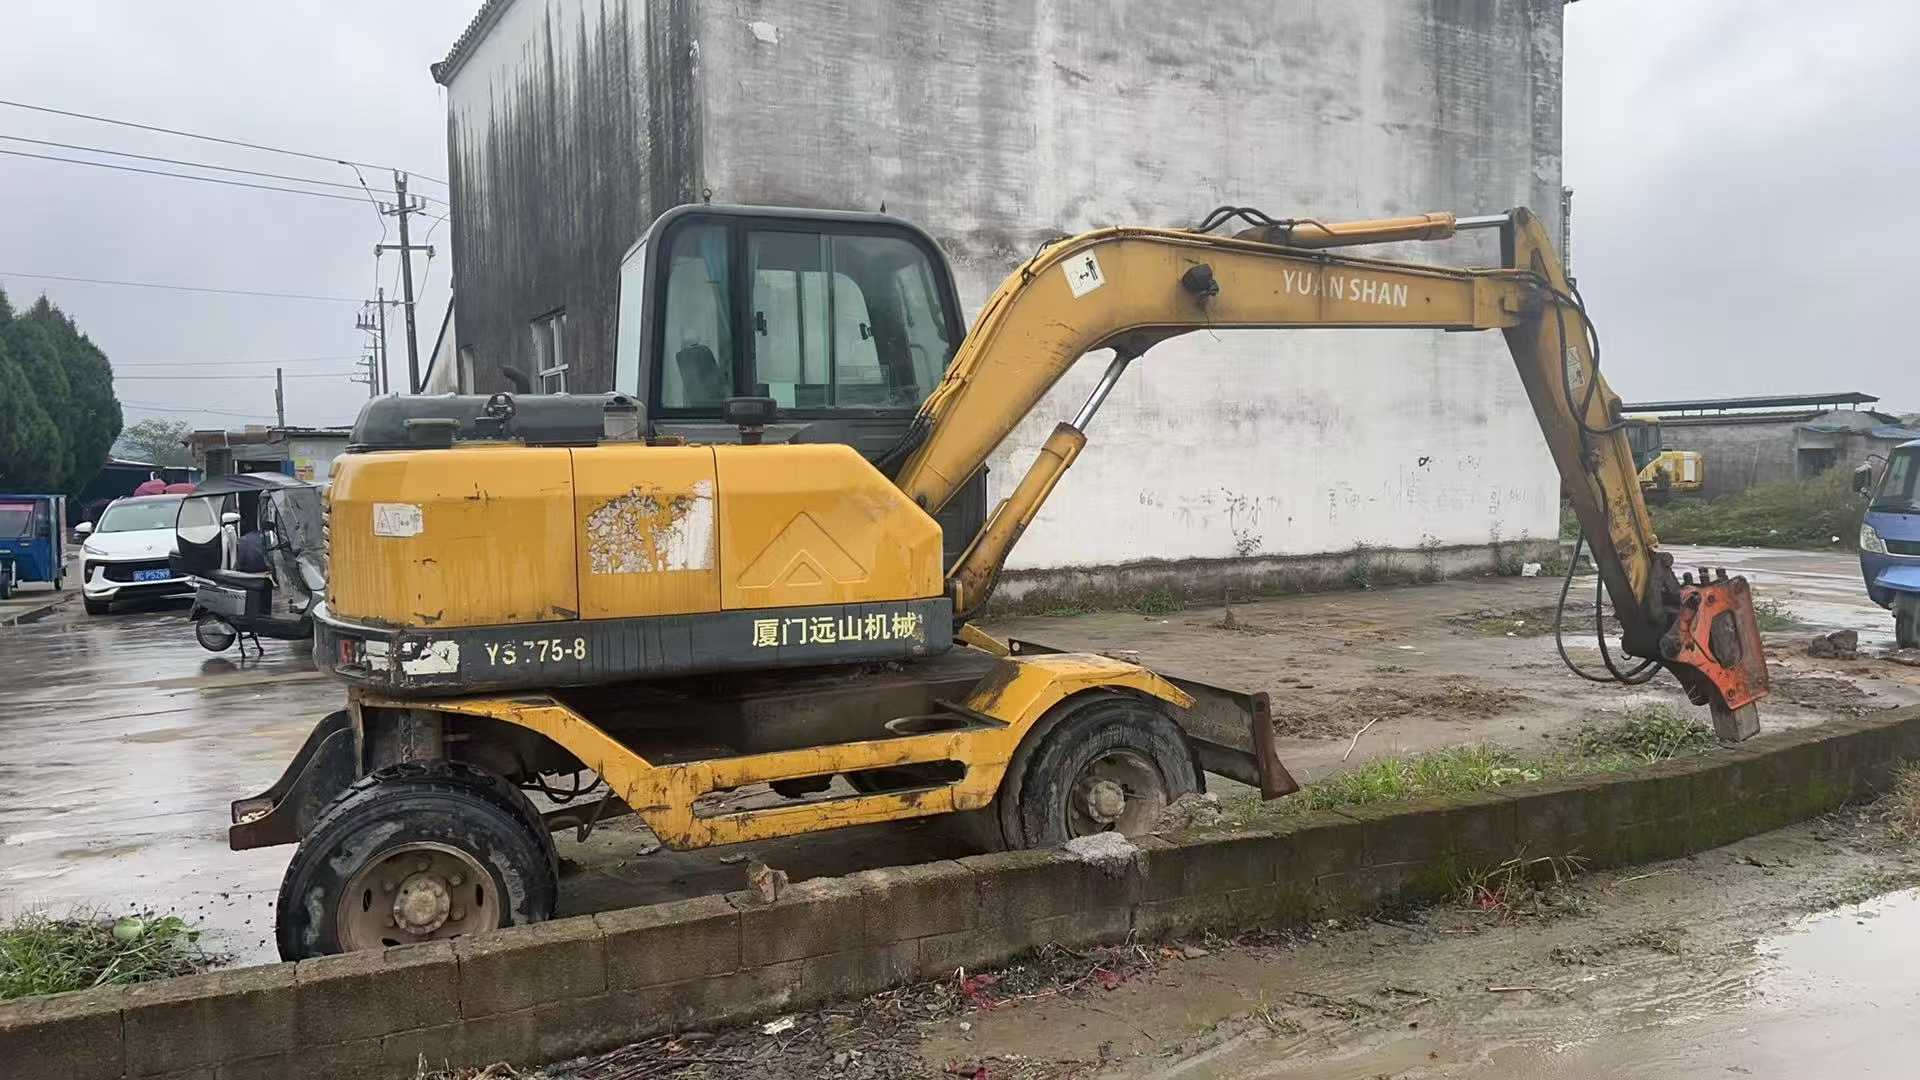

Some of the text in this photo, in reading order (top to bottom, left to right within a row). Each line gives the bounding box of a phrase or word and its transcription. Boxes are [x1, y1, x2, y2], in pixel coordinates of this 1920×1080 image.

[1283, 269, 1408, 307] YUAN SHAN
[752, 611, 924, 647] 厦门远山机械
